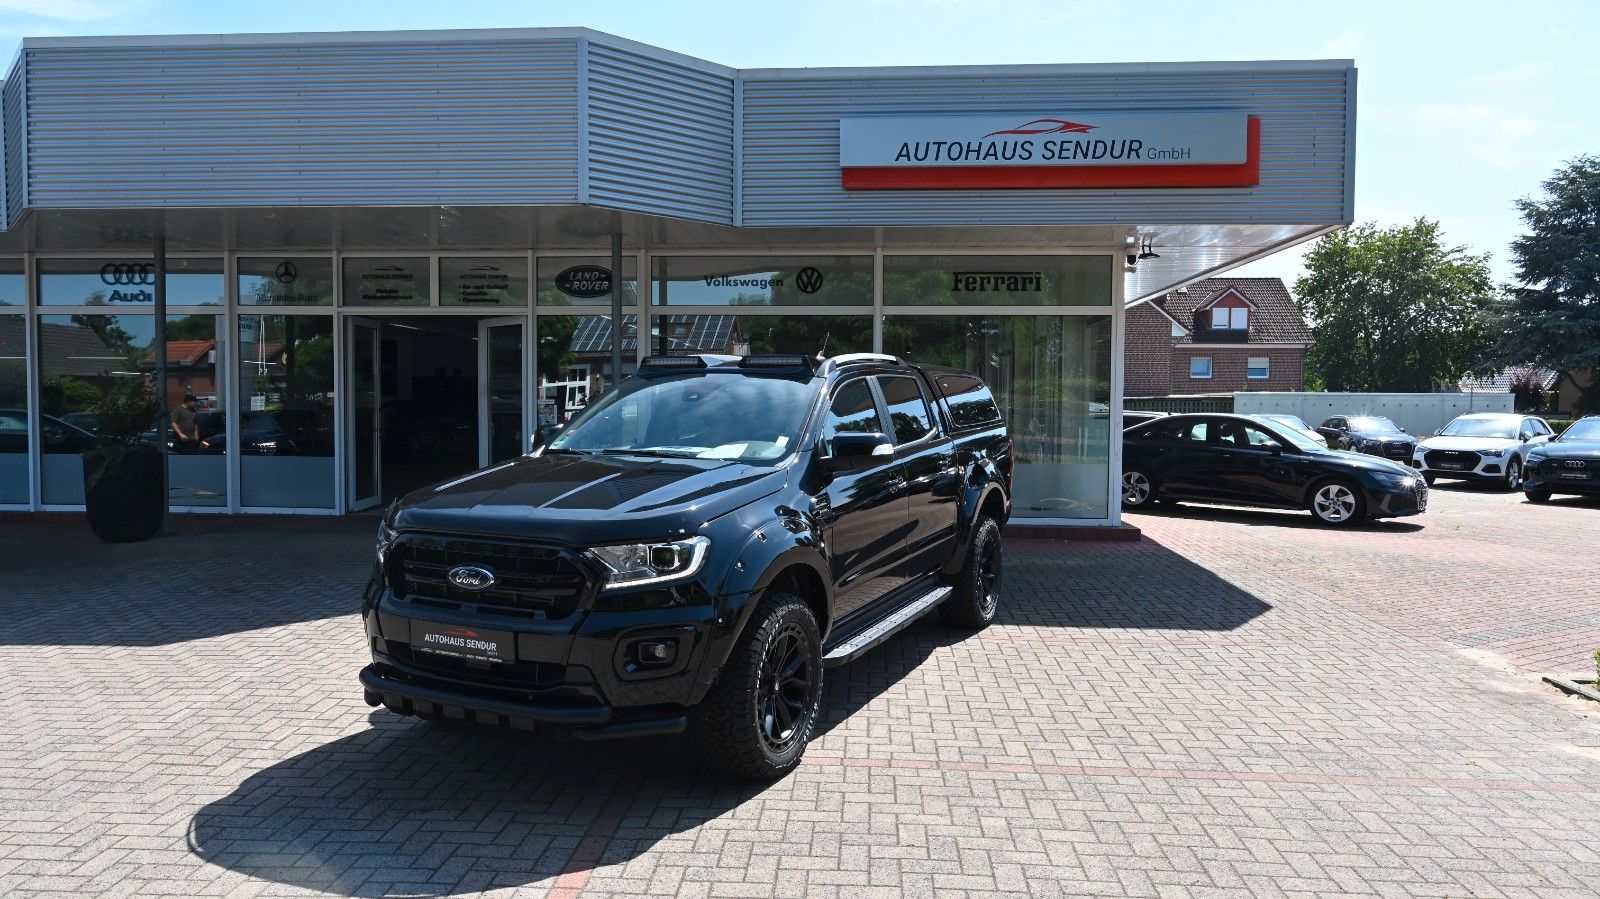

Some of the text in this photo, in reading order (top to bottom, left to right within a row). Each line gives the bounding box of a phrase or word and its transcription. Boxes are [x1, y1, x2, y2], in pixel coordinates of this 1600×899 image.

[895, 139, 1191, 162] AUTOHAUS SENDUR GmbH
[703, 274, 784, 290] Volkswagen
[951, 271, 1042, 292] Ferrari
[108, 289, 153, 303] Audi
[455, 569, 481, 586] Ford
[424, 633, 497, 651] AUTOHAUS SENDUR
